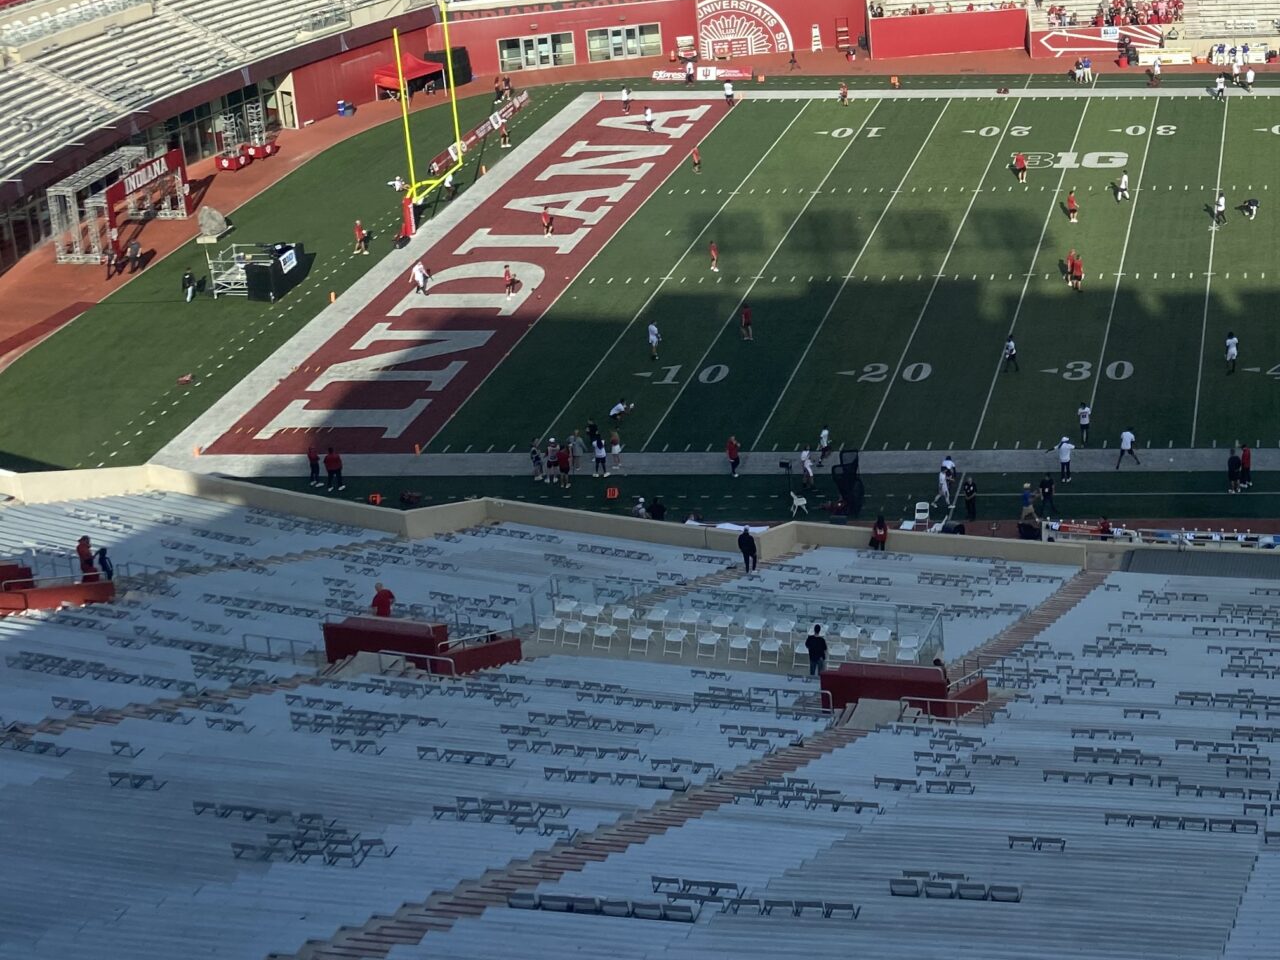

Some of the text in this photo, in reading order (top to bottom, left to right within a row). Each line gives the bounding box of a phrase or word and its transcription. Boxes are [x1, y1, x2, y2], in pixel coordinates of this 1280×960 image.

[697, 0, 777, 28] UNIVERSITATIS
[776, 31, 788, 51] SIG
[124, 157, 168, 194] INDIANA
[253, 104, 712, 440] INDIANA
[651, 364, 731, 384] 10
[856, 362, 932, 383] 20
[1062, 361, 1134, 381] 30
